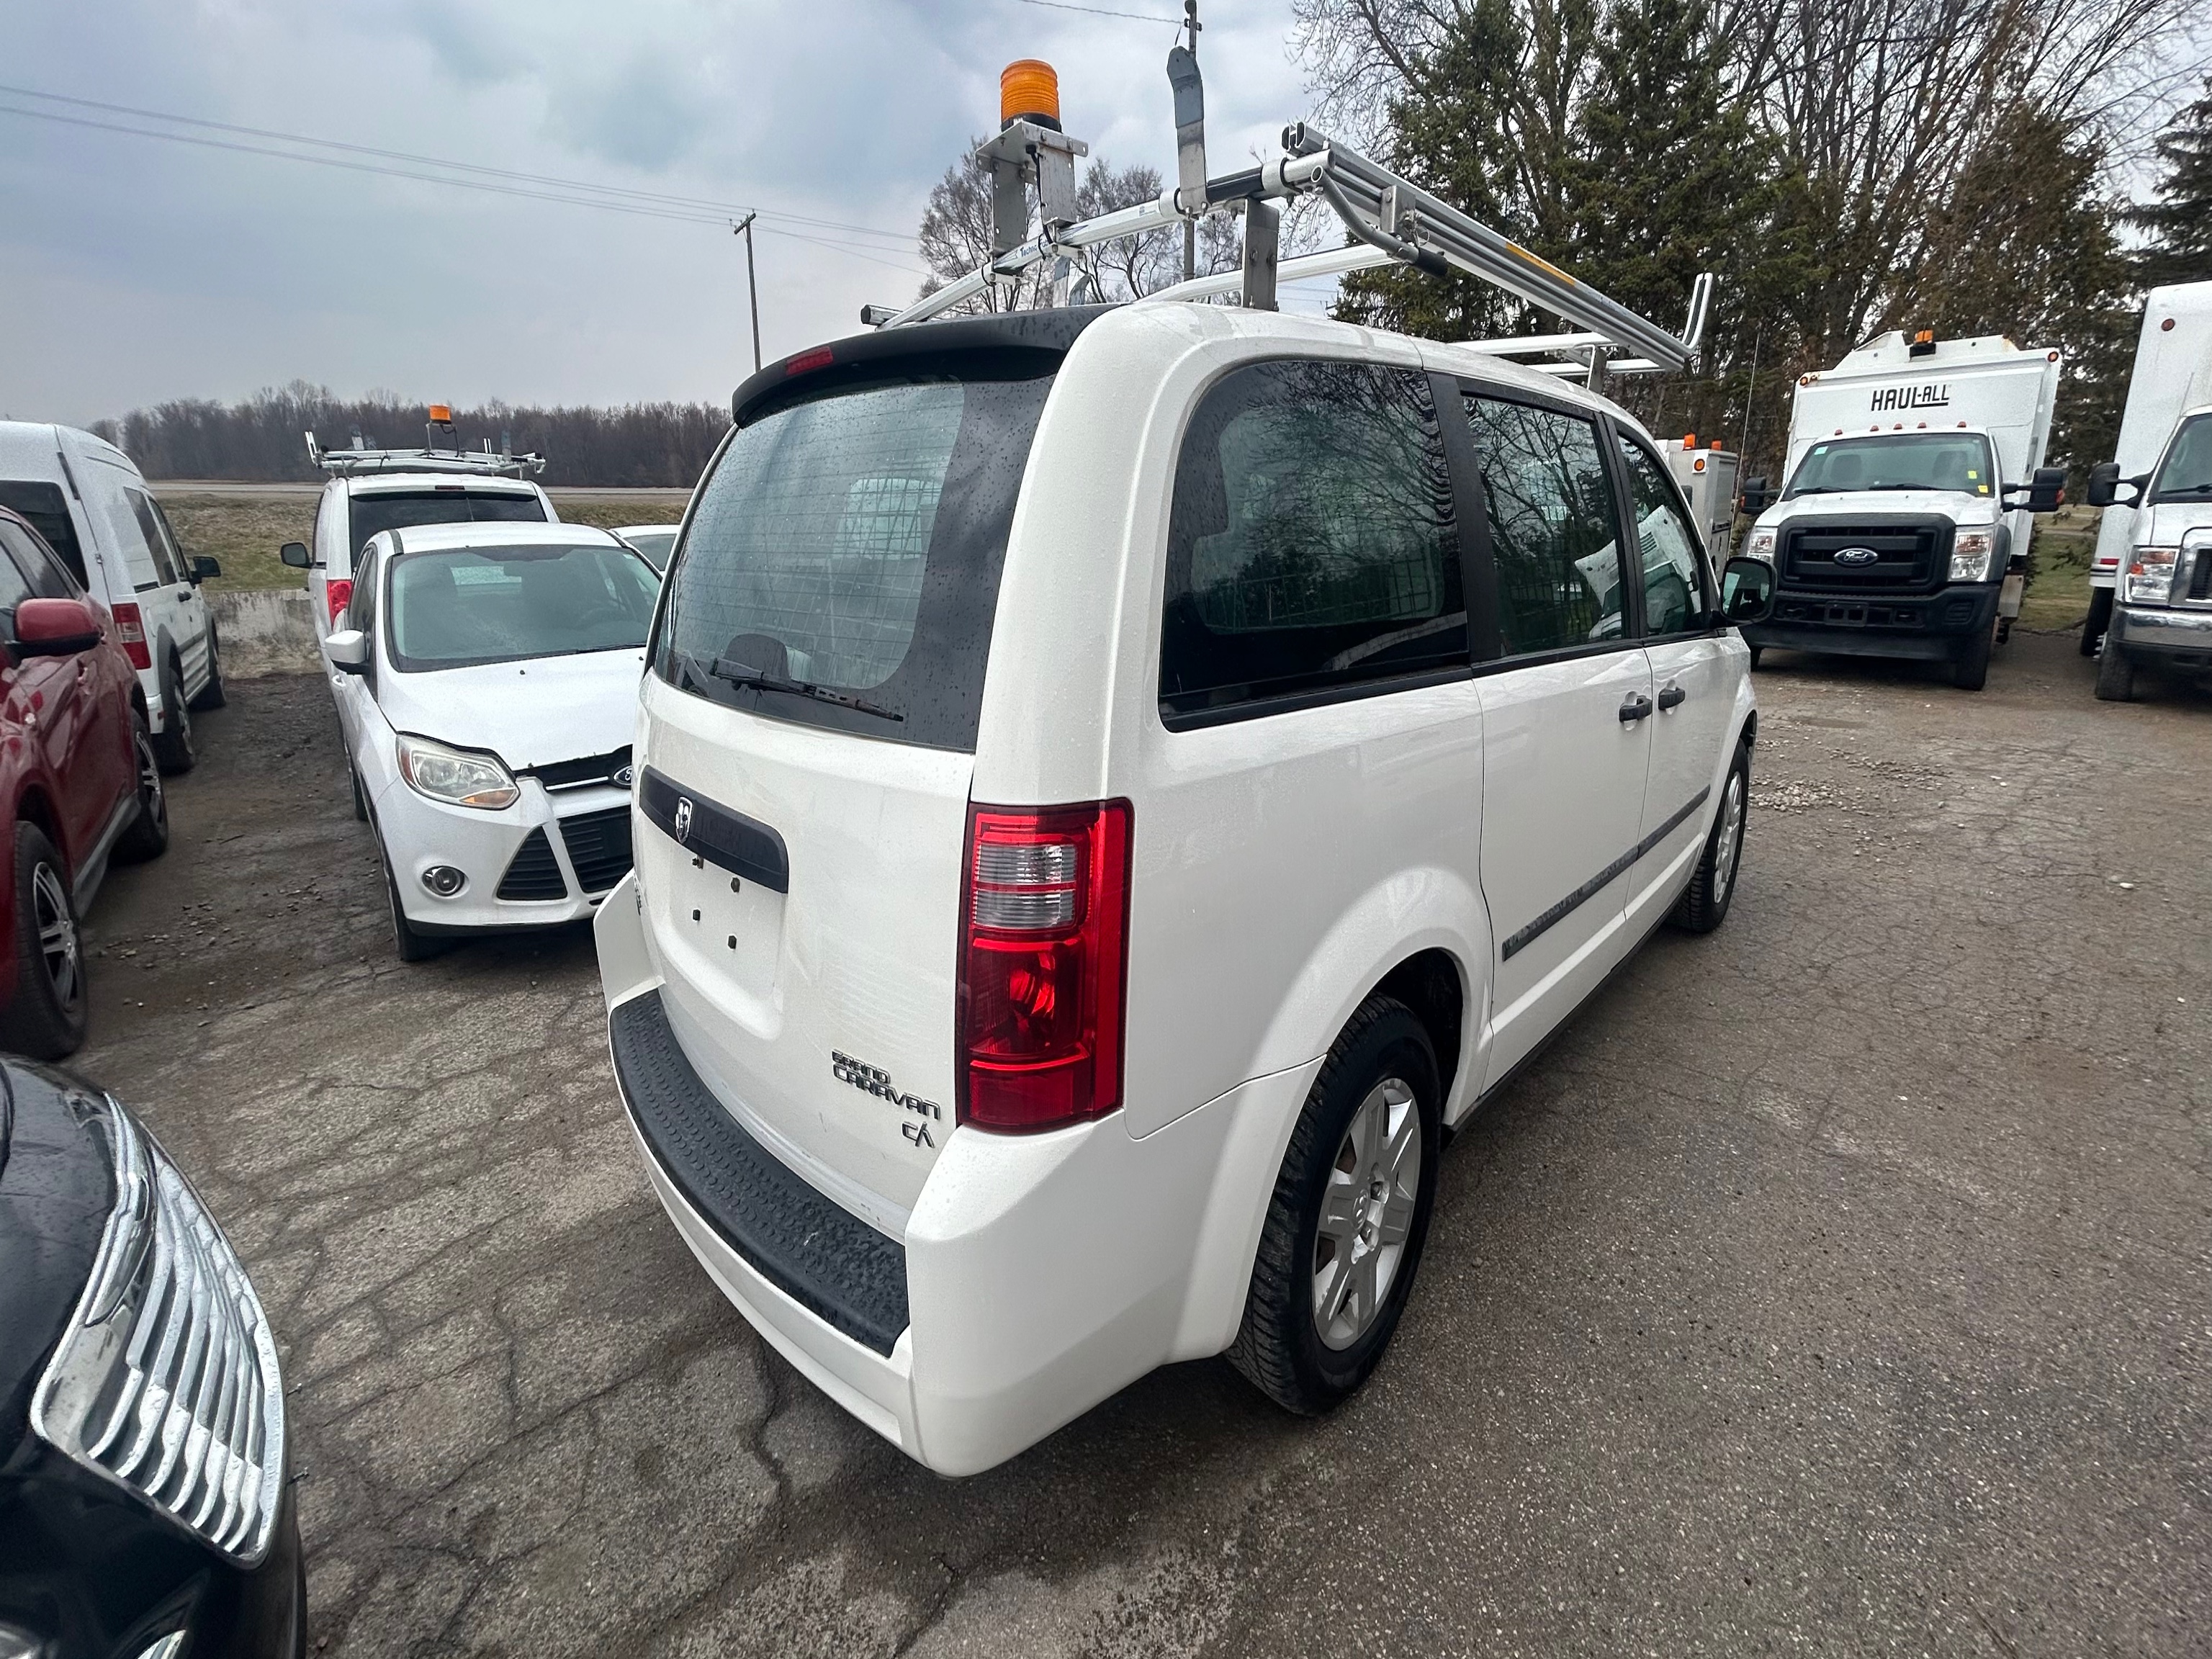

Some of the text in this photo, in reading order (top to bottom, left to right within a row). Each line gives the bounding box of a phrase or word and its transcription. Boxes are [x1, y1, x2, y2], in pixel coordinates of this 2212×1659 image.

[1871, 384, 1950, 411] HAUL-ALL
[1843, 550, 1869, 562] Ford
[832, 1048, 891, 1084] GRAND
[832, 1063, 940, 1120] CARAVAN
